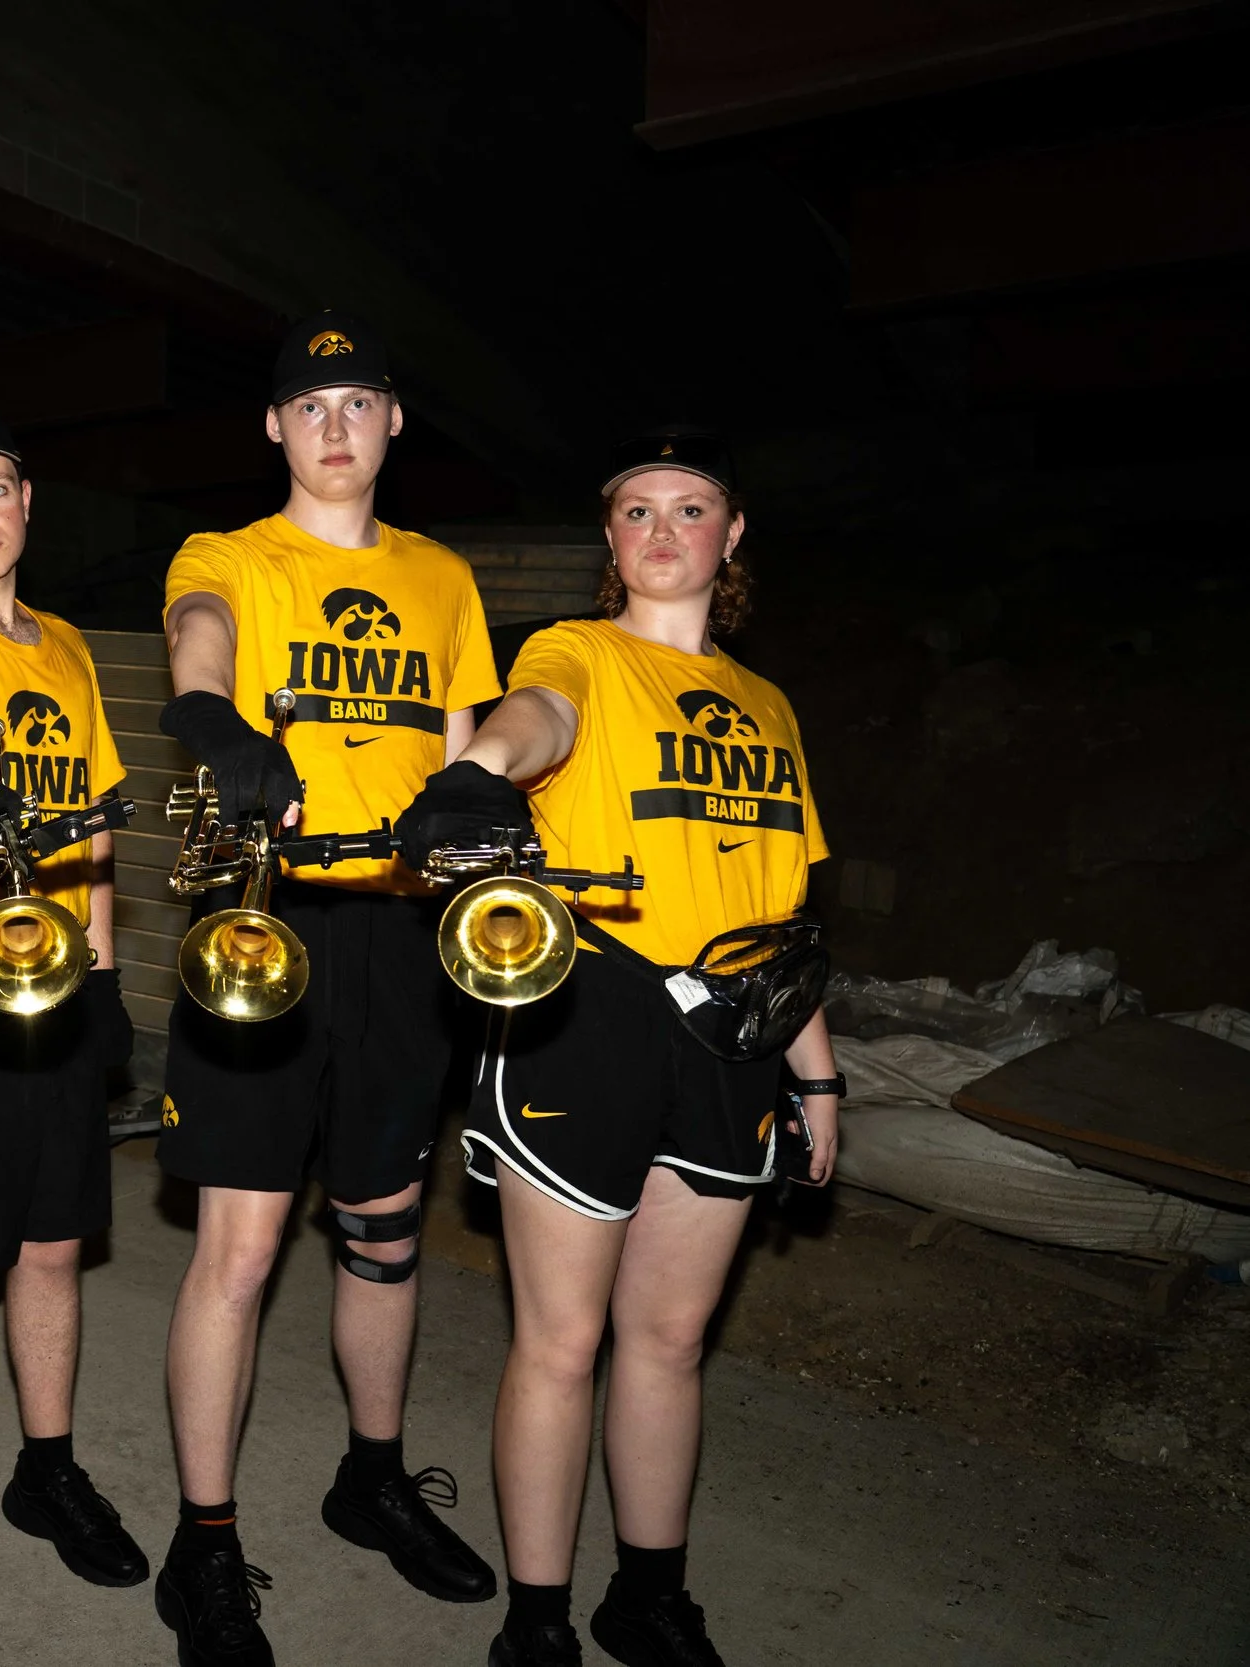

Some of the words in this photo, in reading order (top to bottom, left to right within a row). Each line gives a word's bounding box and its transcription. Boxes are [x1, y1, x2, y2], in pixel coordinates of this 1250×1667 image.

[286, 641, 431, 700] IOWA
[330, 700, 387, 721] BAND
[655, 731, 803, 799] IOWA
[705, 795, 758, 822] BAND
